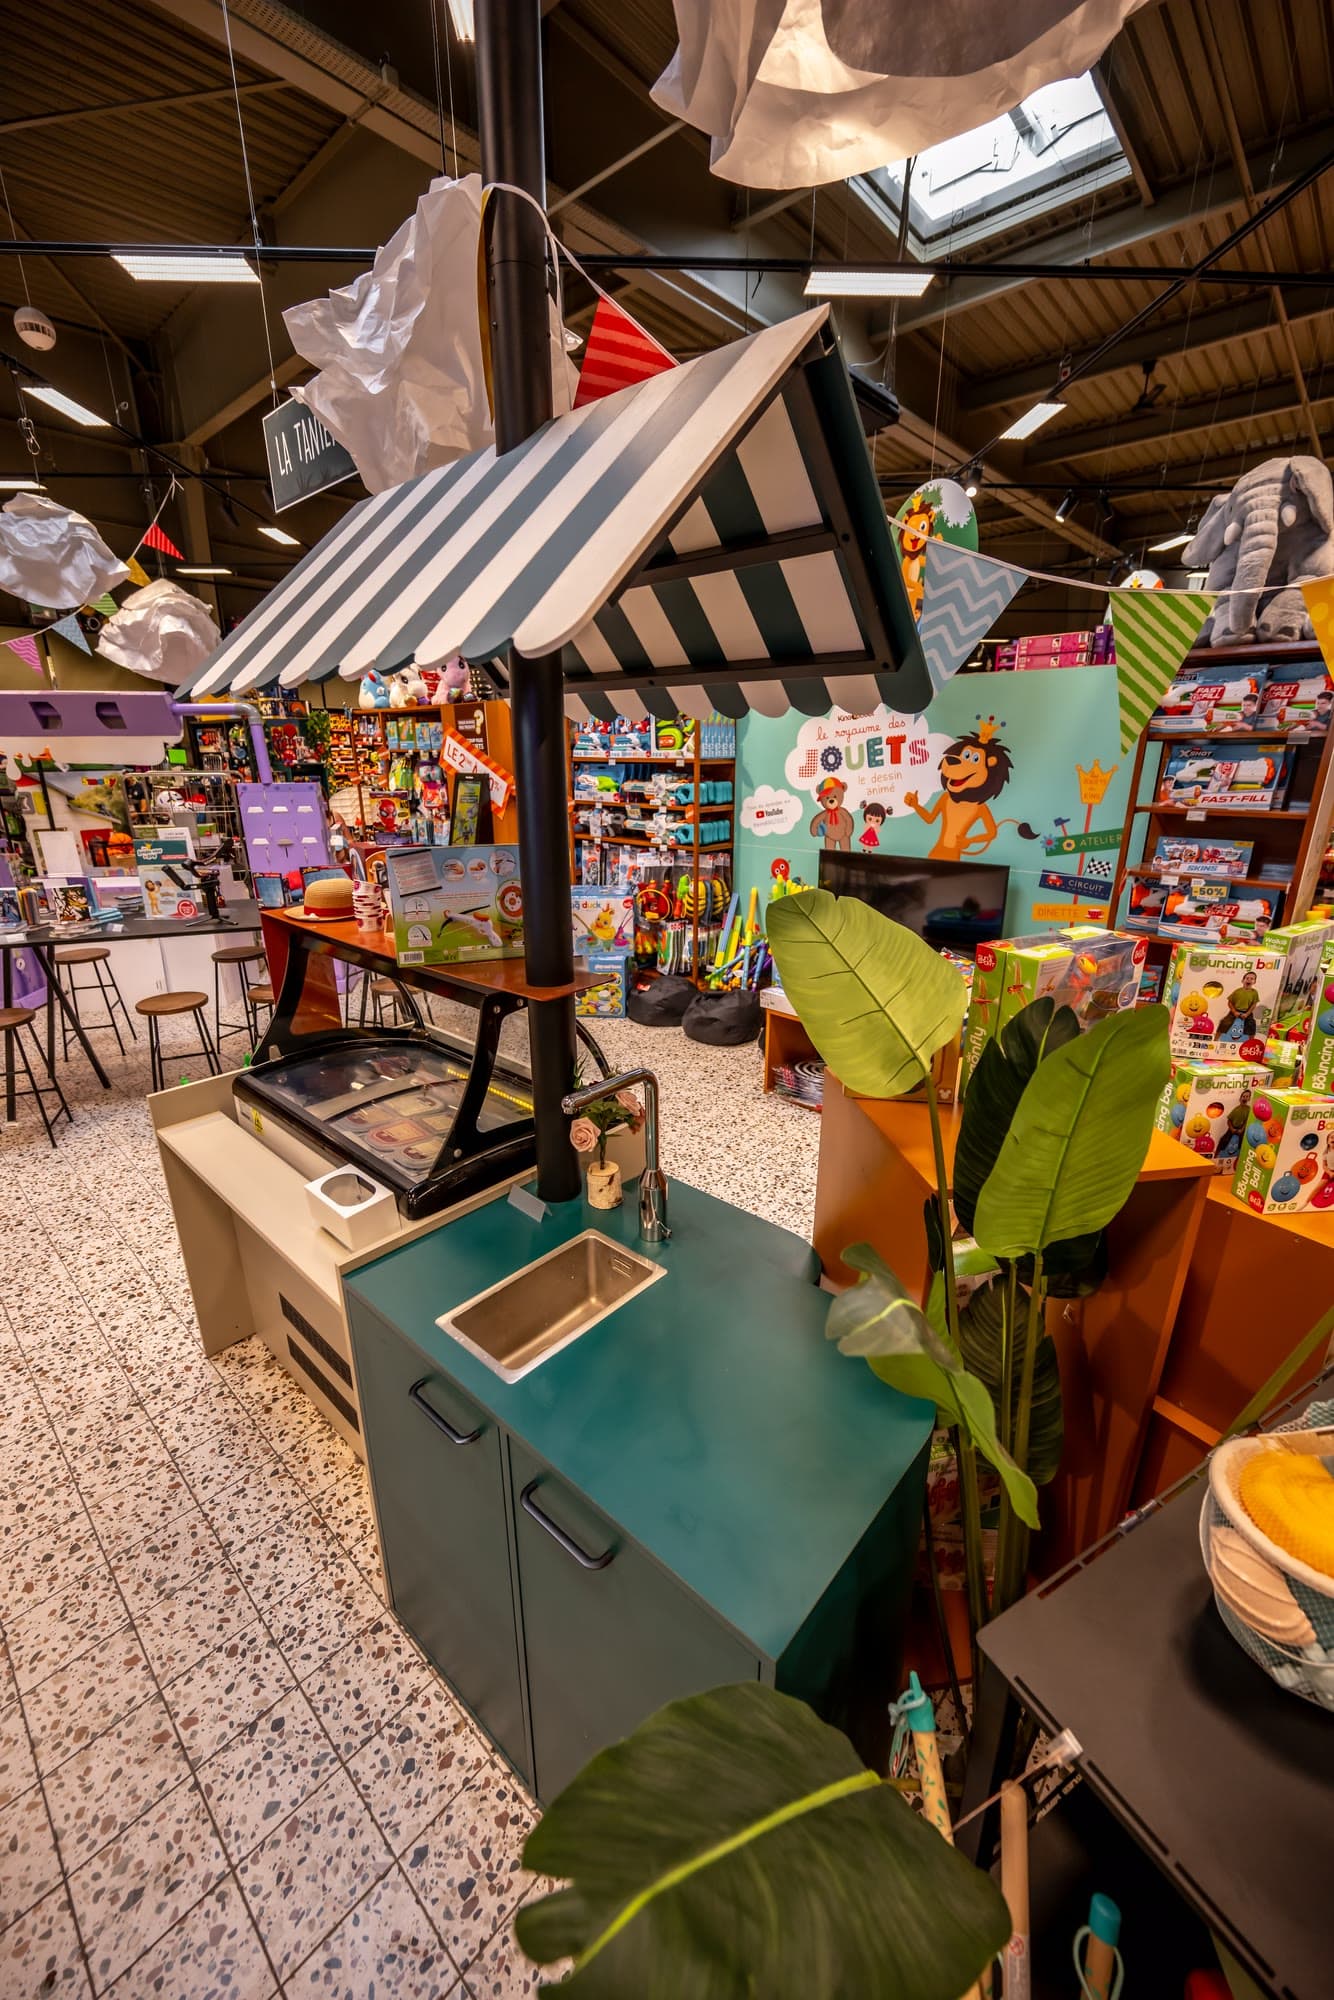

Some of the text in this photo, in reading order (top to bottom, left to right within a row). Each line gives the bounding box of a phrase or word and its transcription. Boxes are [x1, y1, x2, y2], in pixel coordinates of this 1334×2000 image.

[274, 415, 336, 476] LA TANIE
[1197, 686, 1222, 695] FAST
[816, 716, 906, 743] le royaume des
[798, 734, 930, 778] JOUETS
[857, 772, 902, 784] le dessin
[866, 784, 895, 796] animé
[1200, 793, 1268, 803] FAST-FILL
[765, 808, 783, 818] YouTube
[1079, 833, 1123, 848] ATELIER
[1068, 878, 1104, 892] CIRCUIT
[1193, 887, 1225, 897] -50%
[1036, 907, 1081, 919] DINETTE
[1189, 957, 1280, 971] Bouncing ball
[1195, 1074, 1271, 1090] Bouncing ball
[1157, 1106, 1170, 1131] cing
[1291, 1108, 1334, 1121] Bounci
[1236, 1149, 1257, 1198] Bouncing
[1249, 1167, 1262, 1188] Ball
